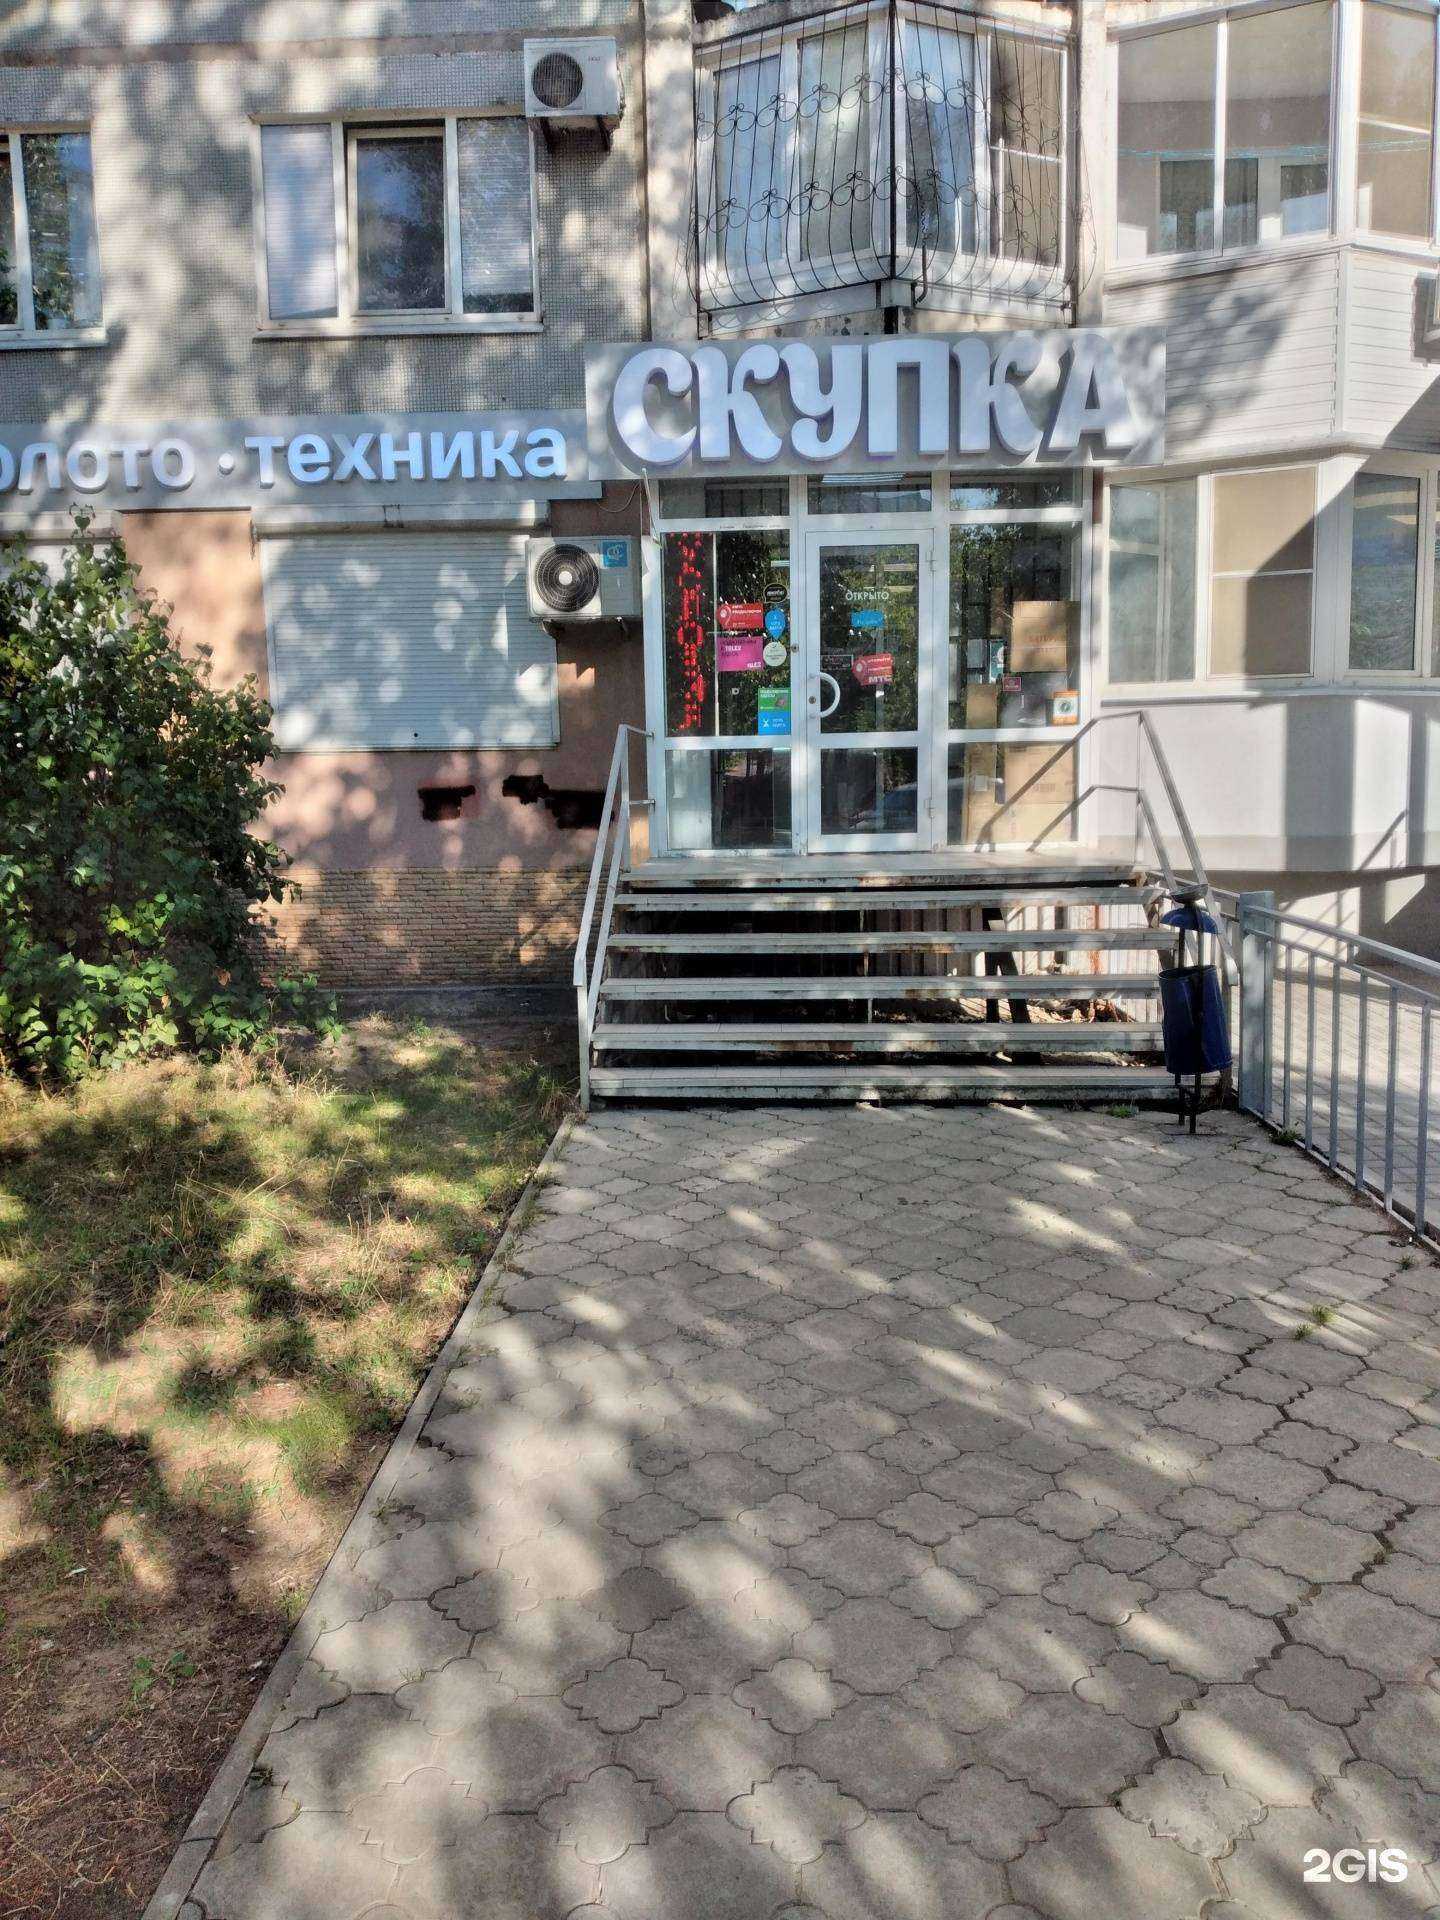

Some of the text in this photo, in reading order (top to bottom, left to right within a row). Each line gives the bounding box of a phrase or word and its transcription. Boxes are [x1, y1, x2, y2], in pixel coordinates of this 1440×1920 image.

[613, 335, 1139, 466] СКУПКА
[245, 425, 567, 486] техника
[845, 590, 889, 601] ОТКРЫТО
